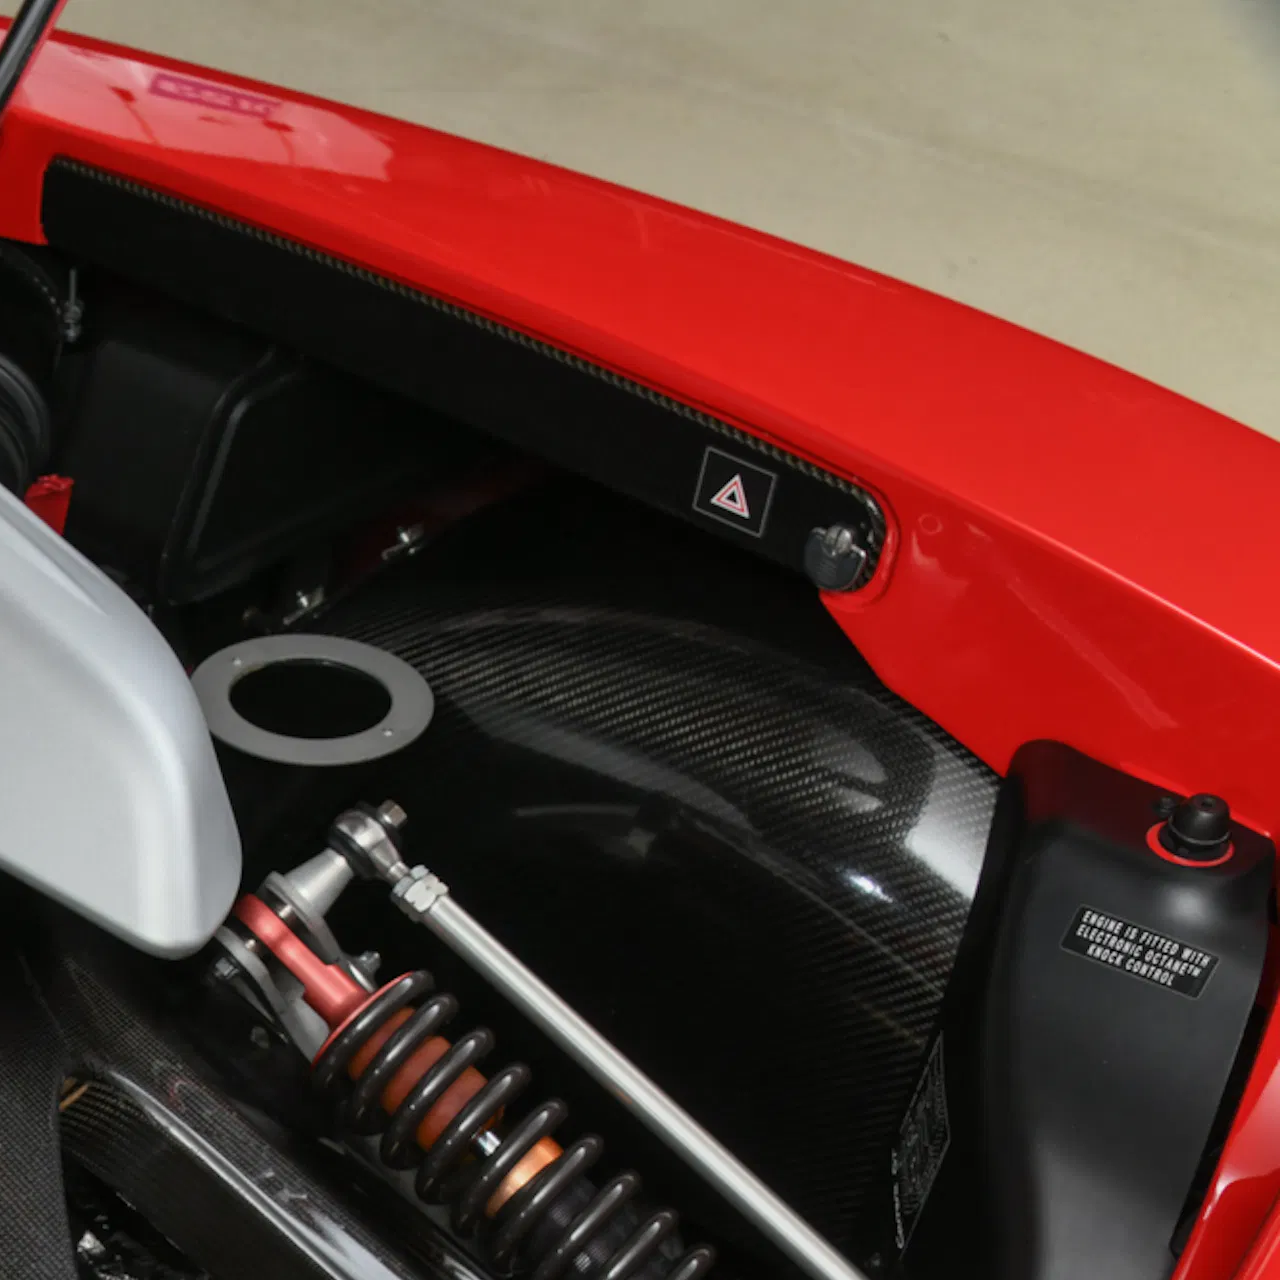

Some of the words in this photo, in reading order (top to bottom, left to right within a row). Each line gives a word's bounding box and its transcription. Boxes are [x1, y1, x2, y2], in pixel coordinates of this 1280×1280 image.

[1076, 923, 1143, 957] ELECTRONIC
[1081, 910, 1124, 935] ENGINE
[1124, 926, 1139, 940] IS
[1139, 931, 1180, 956] FITTED
[1181, 948, 1212, 968] WITH
[1087, 943, 1124, 966] KNOCK
[1125, 958, 1175, 986] CONTROL
